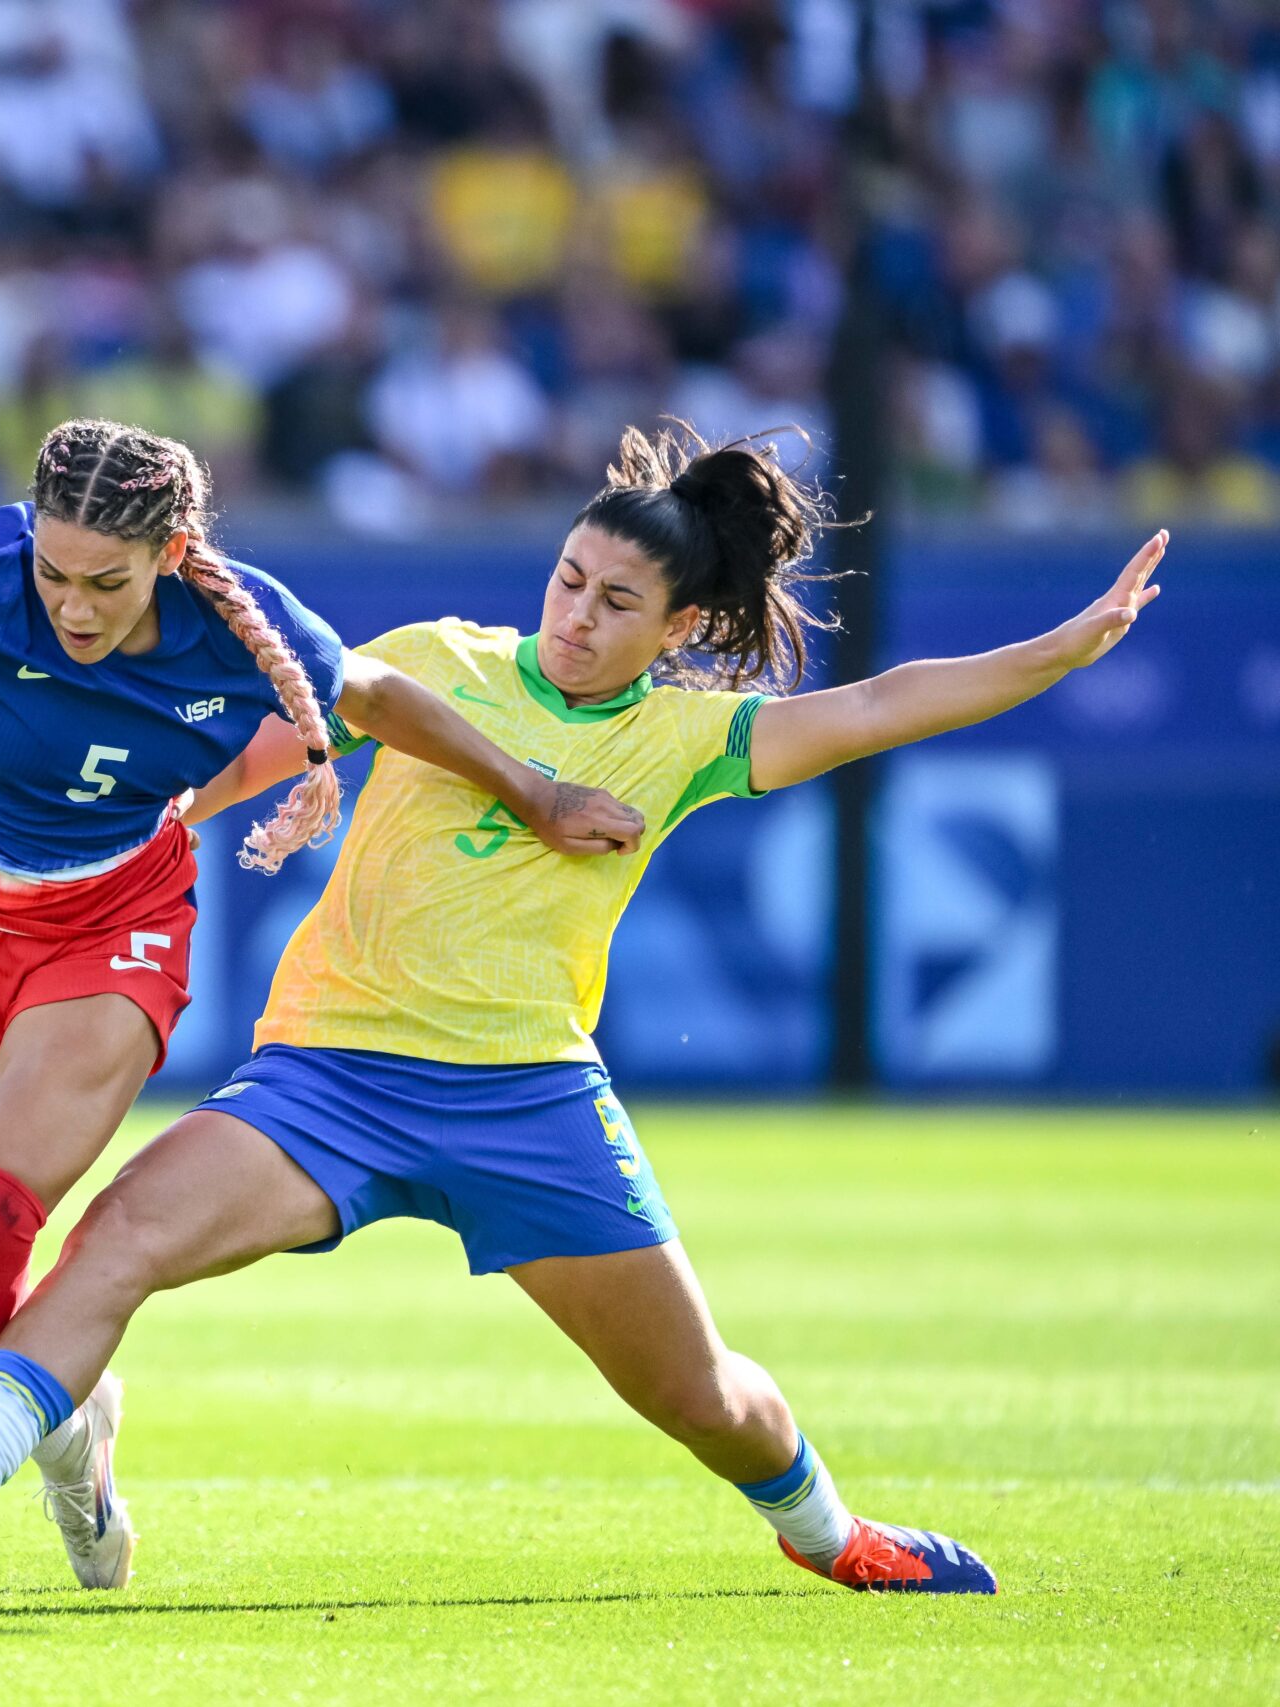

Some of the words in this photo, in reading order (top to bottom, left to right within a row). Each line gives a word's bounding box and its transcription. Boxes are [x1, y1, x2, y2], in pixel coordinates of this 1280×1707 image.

[175, 697, 225, 722] USA
[66, 744, 130, 802] 5
[454, 799, 528, 858] 5
[593, 1096, 641, 1176] 5
